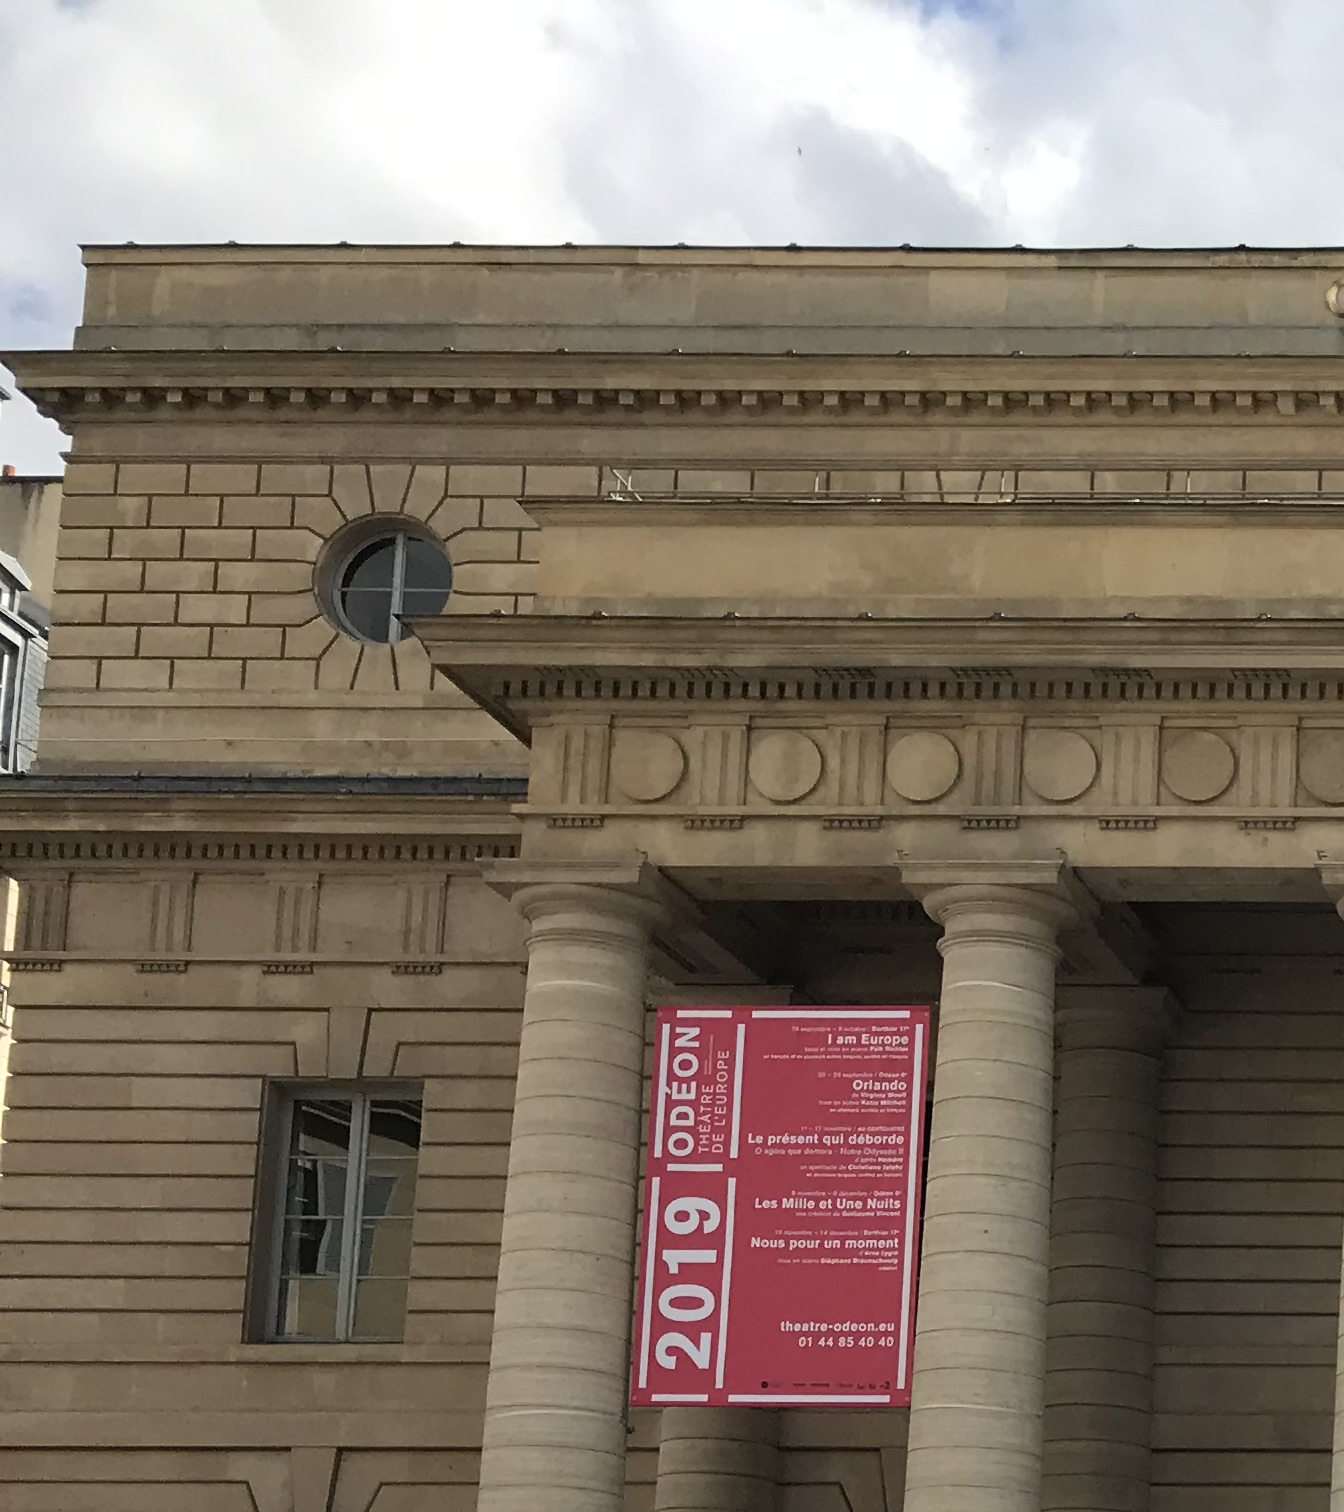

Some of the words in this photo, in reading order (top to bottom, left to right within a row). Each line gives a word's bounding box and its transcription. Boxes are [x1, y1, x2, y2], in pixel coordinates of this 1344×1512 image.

[828, 1034, 832, 1044] I
[836, 1035, 856, 1044] am
[861, 1034, 909, 1046] Europe
[665, 1027, 700, 1157] ODÉON
[714, 1051, 730, 1126] L'EUROPE
[852, 1080, 907, 1091] Orlando
[712, 1134, 725, 1153] DE
[748, 1133, 763, 1144] Le
[767, 1133, 819, 1146] présent
[822, 1133, 844, 1146] qui
[848, 1133, 904, 1145] déborde
[754, 1198, 778, 1209] Les
[782, 1198, 815, 1209] Mille
[819, 1199, 832, 1209] et
[837, 1199, 863, 1209] Une
[867, 1198, 901, 1209] Nuits
[751, 1237, 785, 1248] Nous
[789, 1238, 820, 1250] pour
[824, 1239, 841, 1248] un
[845, 1238, 899, 1248] moment
[655, 1196, 721, 1370] 2019
[780, 1321, 895, 1332] theatre-odeon.eu
[799, 1337, 813, 1347] 01
[817, 1337, 834, 1347] 44
[838, 1337, 854, 1347] 85
[858, 1337, 874, 1347] 40
[879, 1337, 894, 1347] 40
